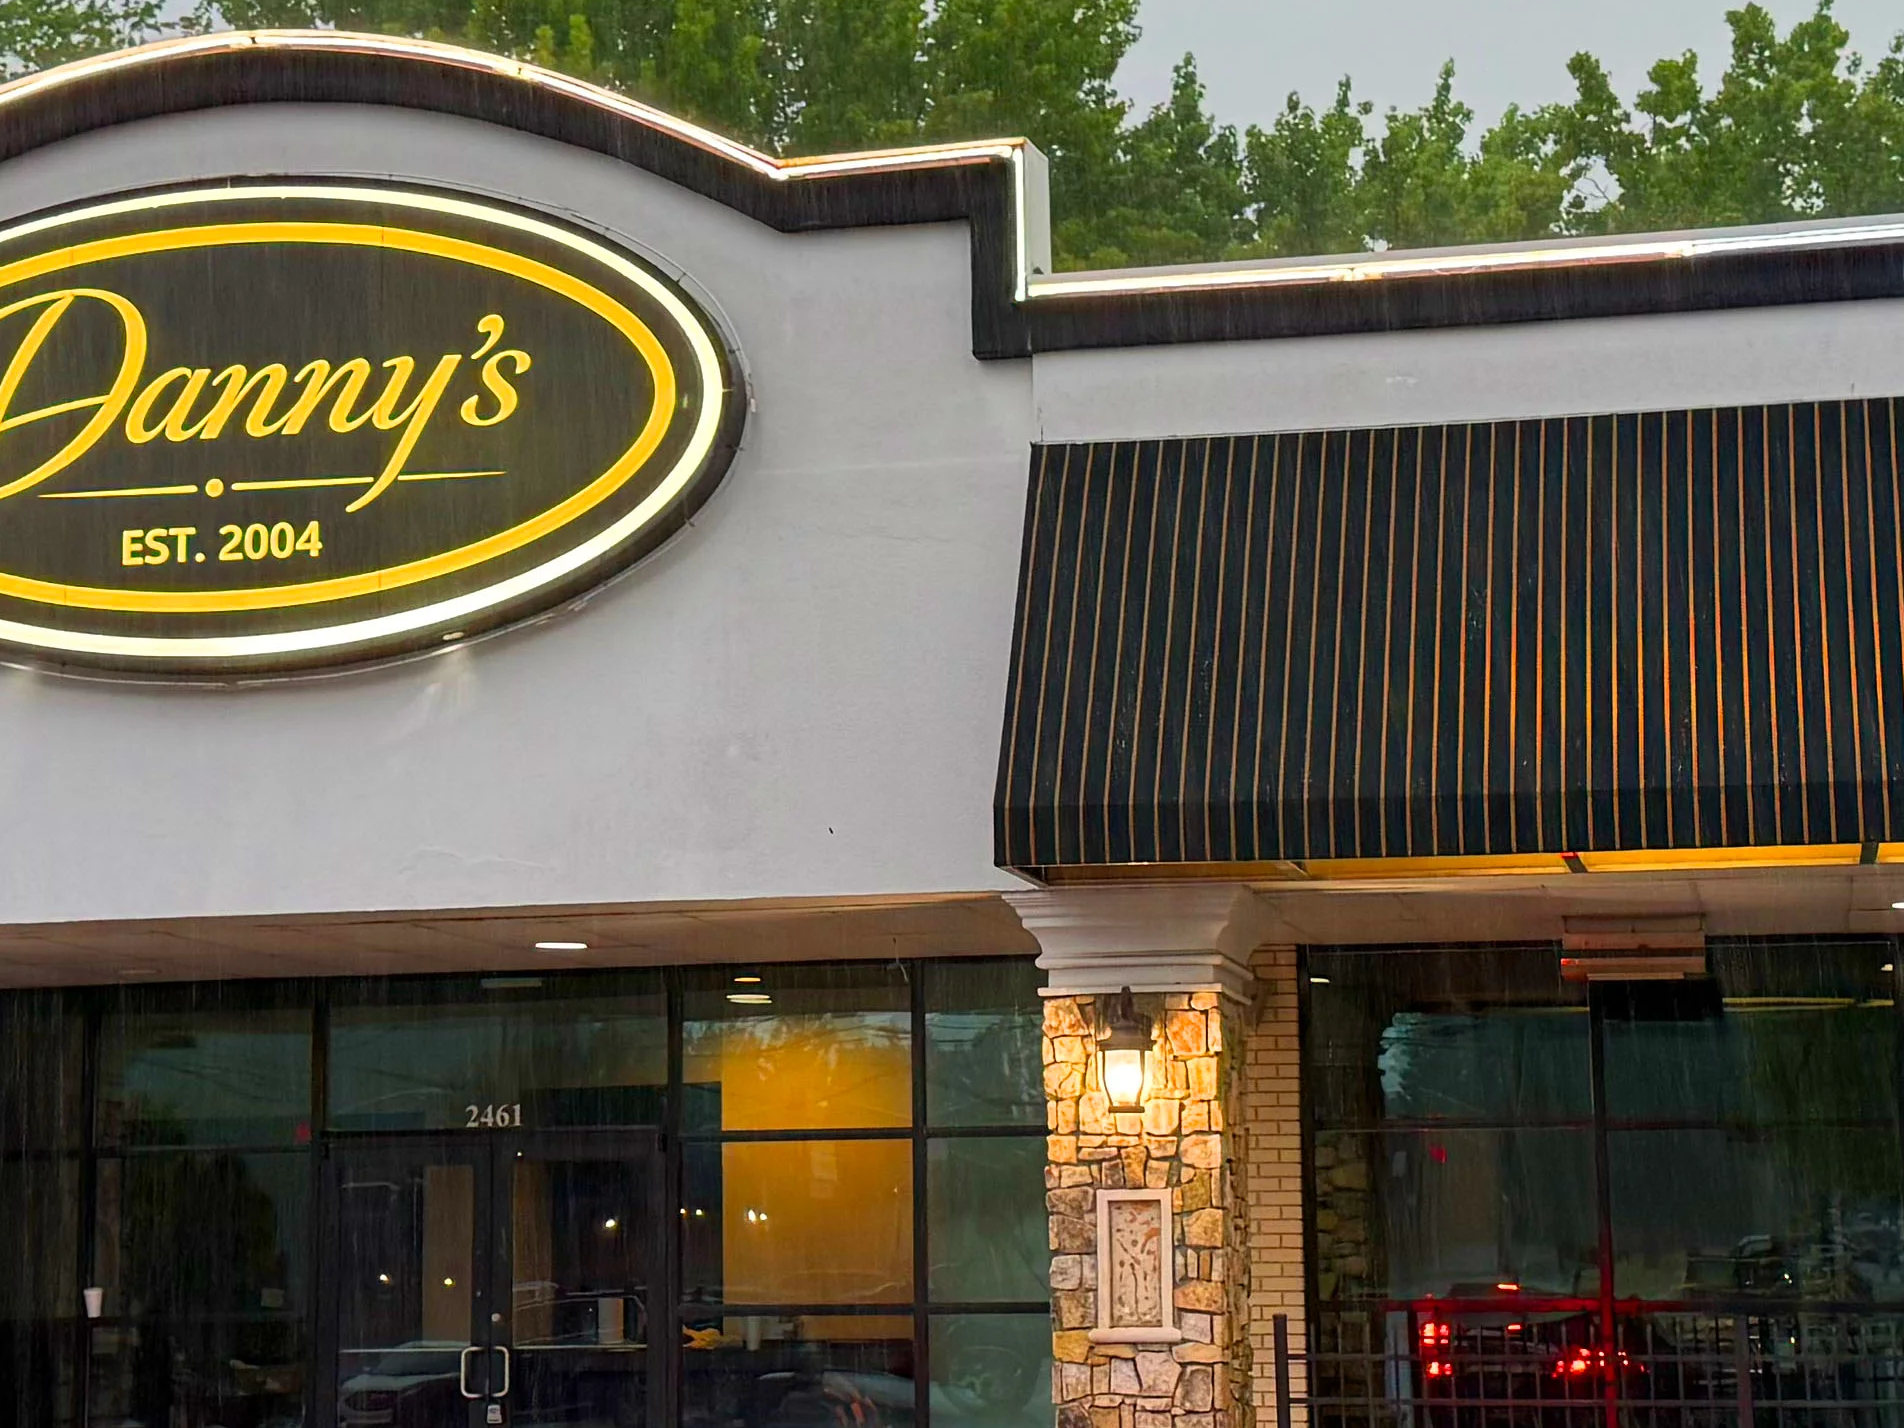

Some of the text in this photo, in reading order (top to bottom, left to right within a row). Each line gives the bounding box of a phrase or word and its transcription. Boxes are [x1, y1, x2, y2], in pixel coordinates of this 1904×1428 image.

[122, 521, 323, 566] EST. 2004
[465, 1104, 521, 1128] 2461
